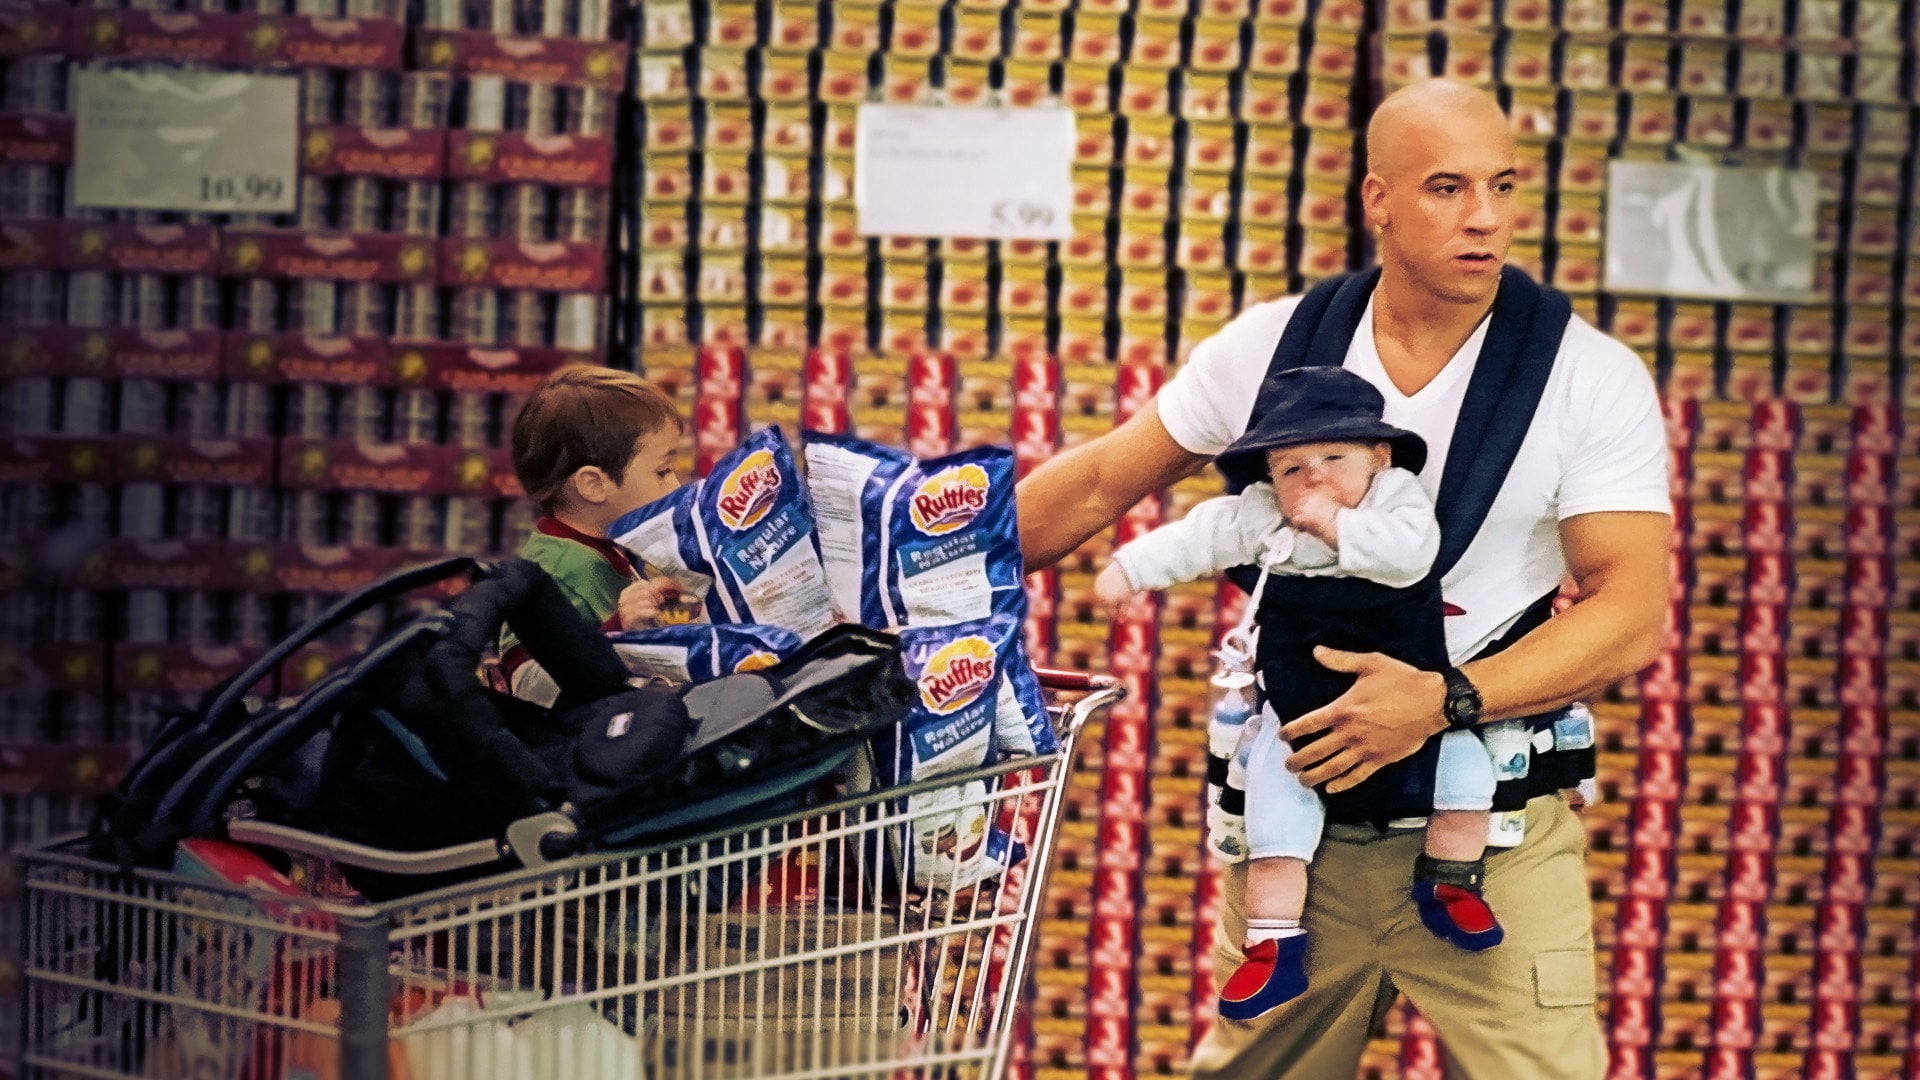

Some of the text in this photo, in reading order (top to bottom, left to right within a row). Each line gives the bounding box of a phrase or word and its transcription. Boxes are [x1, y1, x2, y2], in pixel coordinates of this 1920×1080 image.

[736, 511, 789, 563] Regular
[749, 525, 797, 570] Nure
[910, 532, 977, 562] Regular
[922, 657, 992, 702] Ruffles
[924, 704, 986, 744] Regular
